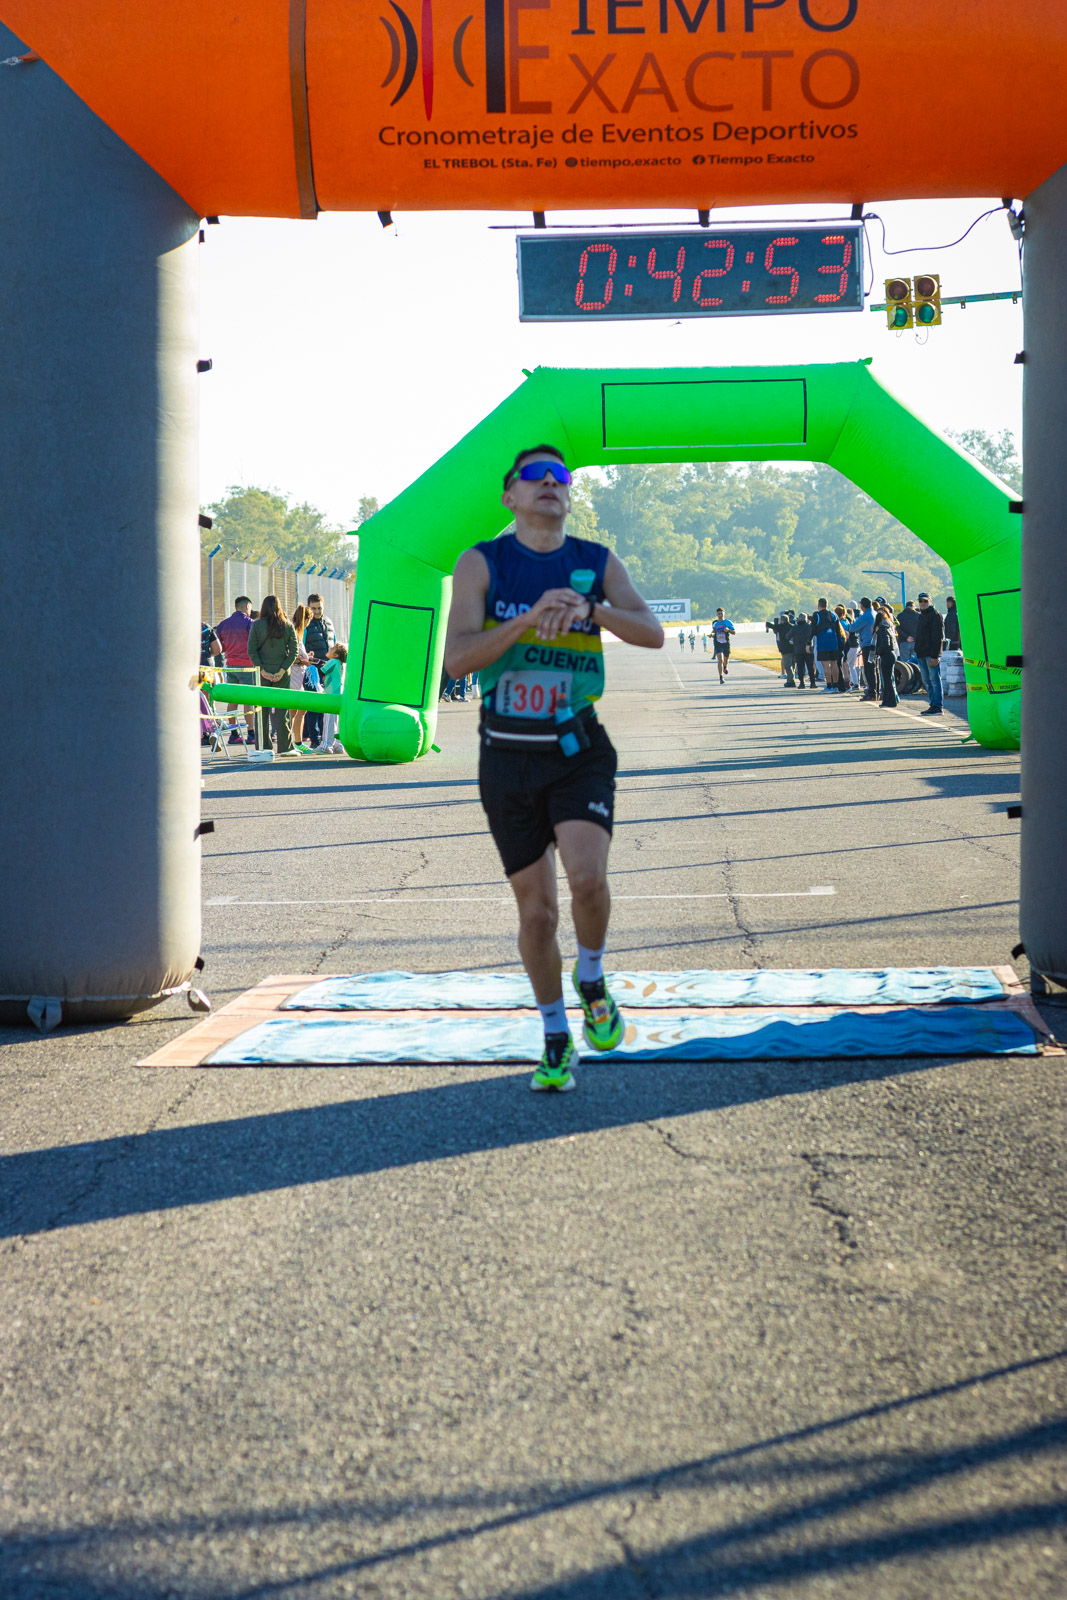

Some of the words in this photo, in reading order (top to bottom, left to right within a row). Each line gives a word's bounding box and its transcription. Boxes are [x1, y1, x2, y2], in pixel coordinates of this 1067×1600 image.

[378, 125, 554, 149] Cronometraje
[562, 123, 593, 144] de
[602, 123, 704, 143] Eventos
[713, 120, 858, 145] Deportivos
[423, 158, 440, 169] EL
[442, 158, 498, 169] TREBOL
[501, 157, 533, 169] (Sta.
[536, 157, 558, 169] Fe)
[580, 156, 682, 169] tiempo.exacto
[708, 154, 764, 166] Tiempo
[767, 153, 815, 165] Exacto
[574, 234, 852, 311] 0:42:53
[649, 604, 682, 613] ONG
[524, 646, 600, 674] CUENTA
[512, 682, 558, 715] 301
